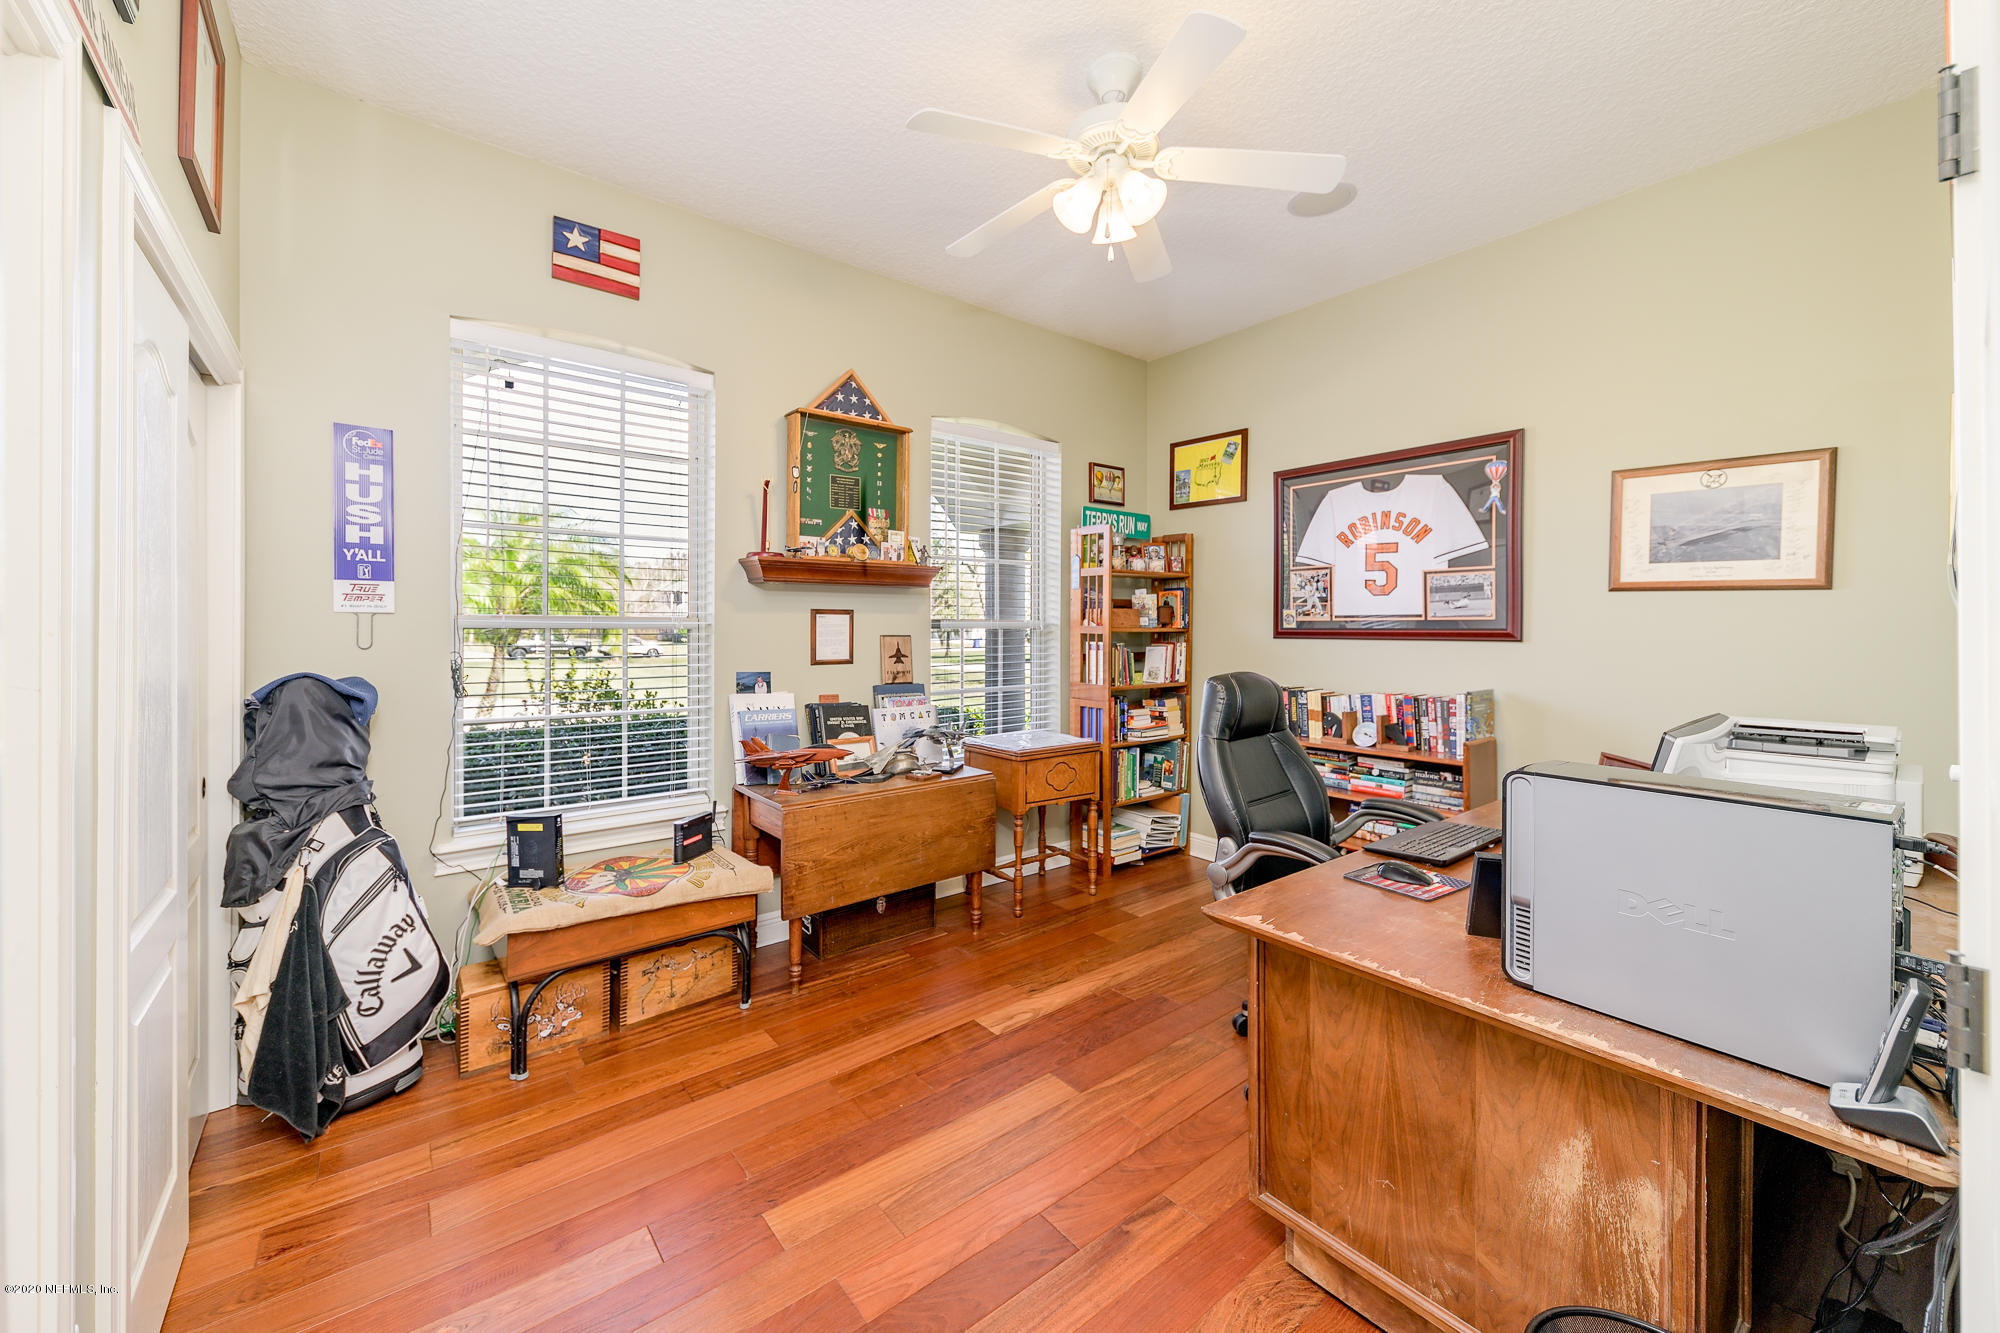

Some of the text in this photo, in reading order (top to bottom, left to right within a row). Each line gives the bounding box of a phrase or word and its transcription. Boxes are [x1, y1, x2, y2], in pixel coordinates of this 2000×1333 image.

[352, 437, 383, 448] FedEx
[345, 462, 384, 545] HUSH
[1118, 515, 1136, 535] RUN
[1136, 521, 1148, 532] WAY
[1336, 510, 1433, 549] ROBINSON
[343, 548, 386, 562] Y'ALL
[1364, 541, 1399, 597] 5
[745, 712, 793, 721] CARRIERS
[1616, 888, 1737, 942] DELL
[354, 913, 417, 1018] Callaway
